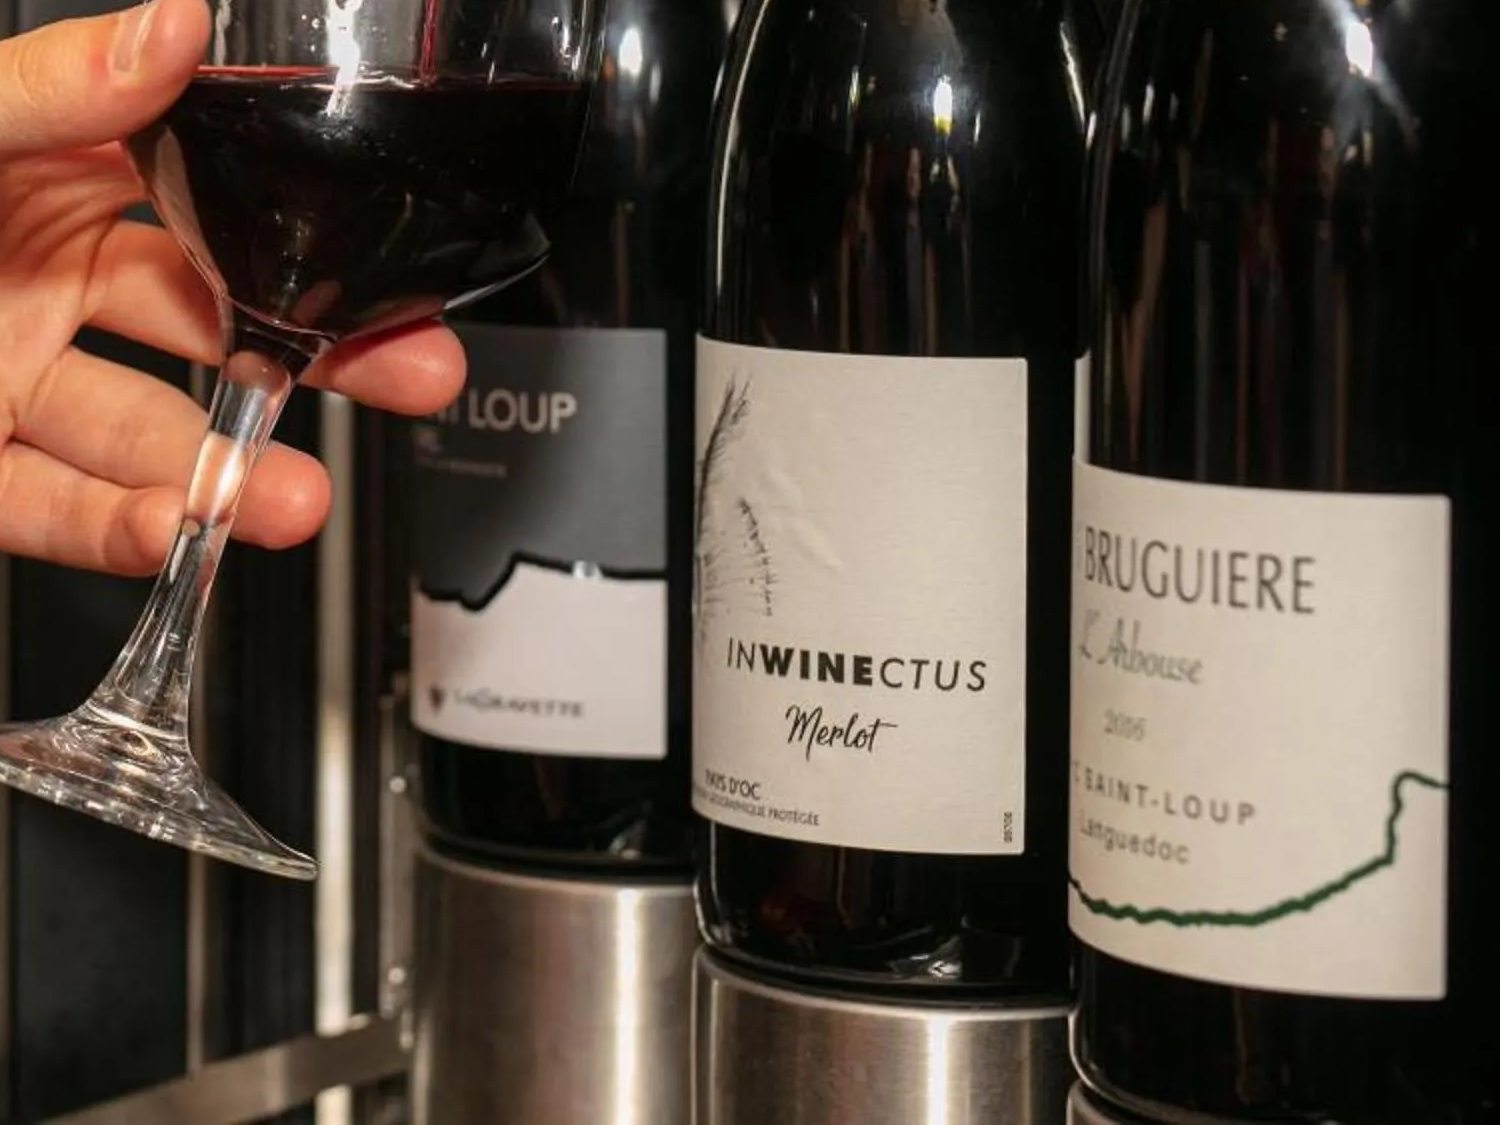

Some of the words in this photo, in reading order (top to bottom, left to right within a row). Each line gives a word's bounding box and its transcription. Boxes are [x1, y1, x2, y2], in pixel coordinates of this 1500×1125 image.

[466, 387, 578, 434] LOUP
[1083, 525, 1315, 614] BRUGUIERE
[726, 636, 988, 692] INWINECTUS
[785, 703, 899, 763] Merlot
[1084, 766, 1256, 826] SAINT-LOUP
